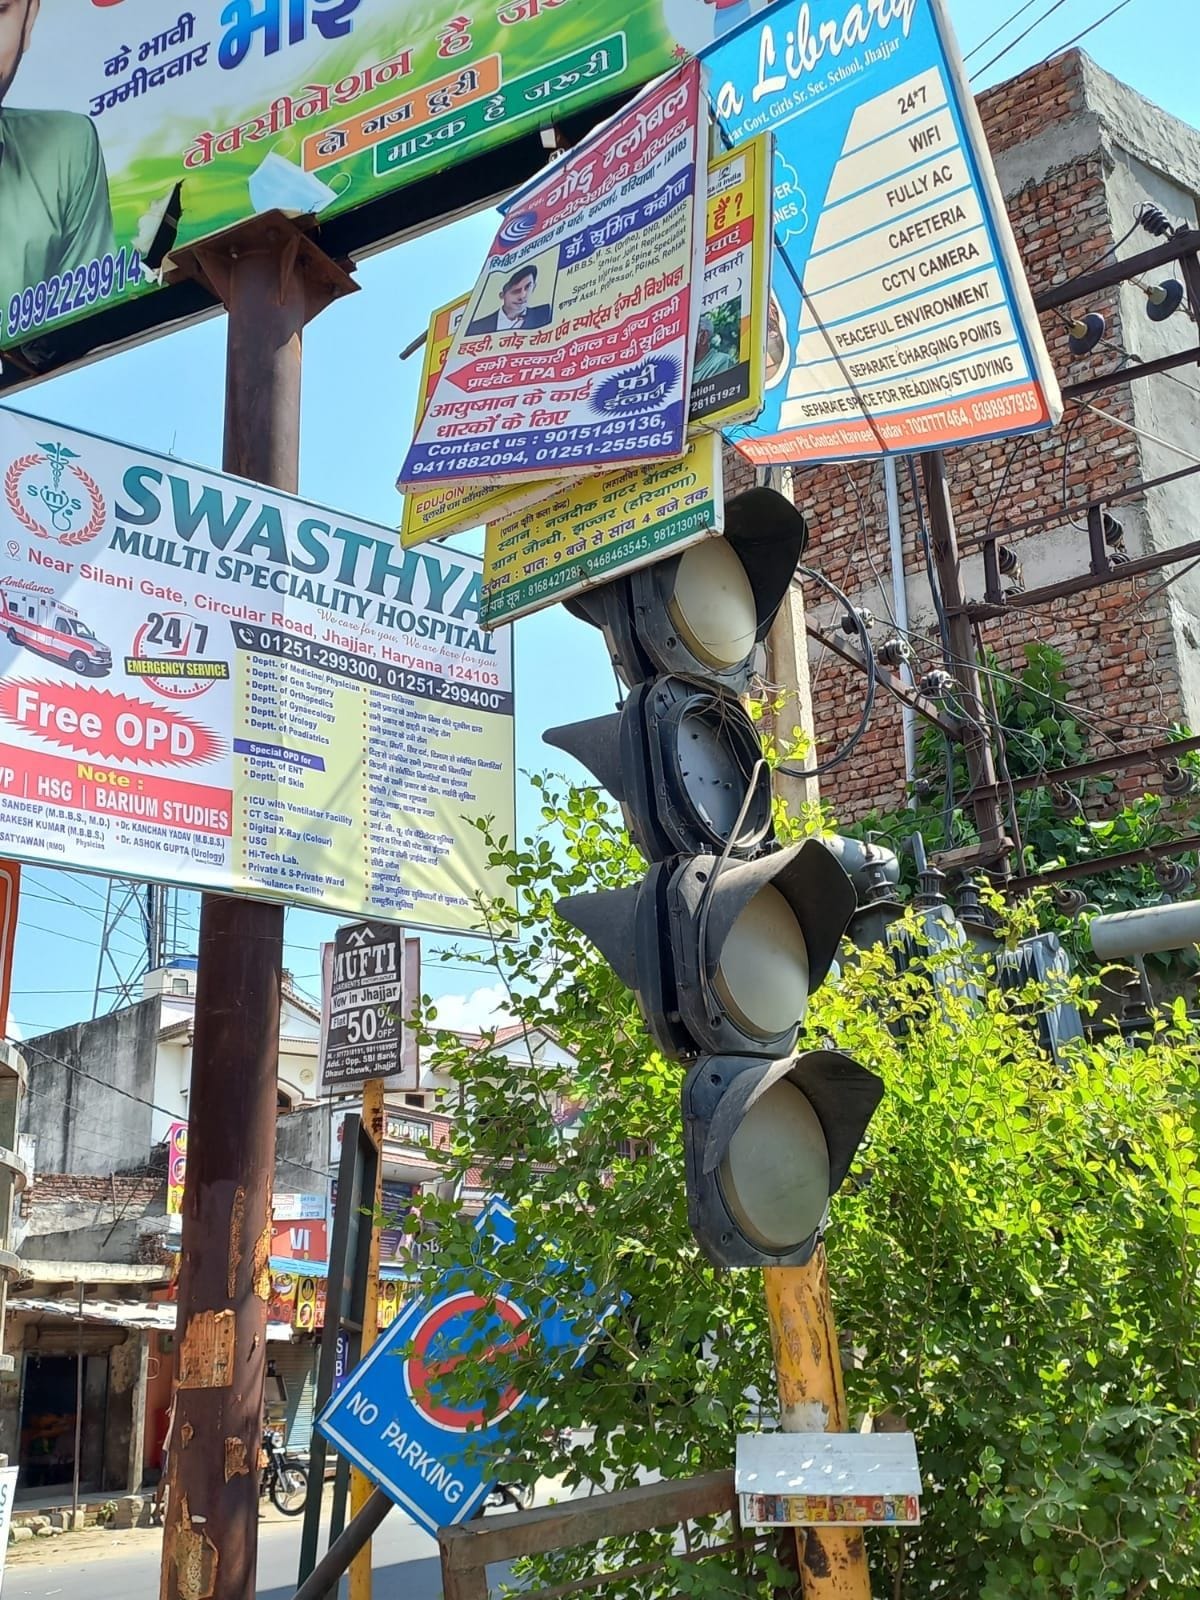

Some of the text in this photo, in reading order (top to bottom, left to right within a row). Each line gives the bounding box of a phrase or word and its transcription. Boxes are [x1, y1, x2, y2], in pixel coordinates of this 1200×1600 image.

[138, 12, 196, 61] भावी
[89, 42, 210, 117] उम्मीदवार
[744, 38, 900, 131] Govt. Girls Sr. Sec. School, Jhajjar
[184, 49, 412, 169] वैक्सीनेशन
[317, 70, 478, 155] दो गज दूरी
[603, 79, 690, 168] ग्लोबल
[388, 117, 466, 161] मास्क
[909, 126, 941, 153] WIFI
[519, 229, 554, 258] अस्पताल
[620, 169, 655, 196] हरियाणा
[664, 138, 687, 166] 124103
[886, 165, 953, 207] FULLY AC
[565, 234, 586, 258] डॉ.
[590, 210, 639, 248] सुमित
[643, 174, 689, 216] कंबोज
[889, 207, 965, 248] CAFETERIA
[572, 225, 687, 294] Sports Spine Specialist
[662, 238, 686, 258] Rohtak
[882, 244, 979, 292] CCTV CAMERA
[8, 247, 141, 336] 9992229914
[475, 296, 680, 373] सभी सरकारी पैनल व अन्य सभी
[836, 282, 990, 348] PEACEFUL ENVIRONMENT
[499, 331, 528, 349] जोड़
[529, 329, 552, 346] रोग
[519, 366, 556, 381] TPA
[581, 351, 618, 370] पैनल
[620, 339, 638, 359] की
[639, 320, 681, 353] सुविधा
[849, 320, 1001, 378] SEPARATE CHARGING POINTS
[430, 378, 593, 419] आयुष्मान कार्ड
[618, 364, 658, 393] फ्री
[801, 356, 1013, 418] SEPARATE SPACE FOR READING/STUDYING
[437, 408, 571, 438] धारकों लिए
[972, 390, 1038, 422] 8398937935
[412, 431, 673, 475] 9411882094, 01251-255565
[428, 413, 666, 457] Contact us 9015149136,
[416, 486, 465, 514] EDUJOIN
[545, 500, 598, 528] नजदीक
[602, 482, 638, 504] वाटर
[490, 551, 518, 571] ग्राम
[624, 472, 696, 513] (हरियाणा)
[554, 551, 561, 562] 9
[566, 537, 588, 556] बजे
[591, 530, 604, 546] से
[642, 513, 651, 524] 4
[656, 497, 680, 517] बजे
[684, 487, 709, 506] तक
[115, 466, 483, 625] SWASTHYA
[587, 536, 651, 571] 9468463545,
[108, 527, 496, 655] MULTI SPECIALITY HOSPITAL
[28, 548, 499, 686] Near Silani Gate, Circular Road, Jhajjar, Haryana 124103
[127, 660, 227, 678] EMERGENCY SERVICE
[260, 632, 500, 709] 01251-299300, 01251-299400
[290, 677, 334, 698] Gen Surgery
[326, 675, 360, 692] Physician
[289, 688, 333, 708] Orthopedics
[289, 701, 335, 723] Gynaecology
[17, 688, 194, 757] Free OPD
[289, 714, 317, 730] Urology
[250, 744, 311, 764] Special OPD for
[288, 765, 303, 775] ENT
[77, 763, 131, 787] Note
[288, 778, 304, 788] Skin
[0, 813, 66, 833] RAKESH KUMAR
[2, 798, 43, 814] SANDEEP
[38, 776, 229, 830] HSG BARIUM STUDIES
[249, 796, 352, 826] ICU with Ventilator Facility
[249, 810, 284, 822] CT Scan
[0, 832, 45, 848] SATYAWAN
[120, 820, 192, 841] Dr. KANCHAN YADAV
[120, 835, 132, 845] Dr.
[133, 838, 161, 850] ASHOK
[163, 843, 190, 856] GUPTA
[191, 848, 225, 863] (Urology)
[249, 822, 332, 847] Digital X-Ray (Colour)
[249, 836, 267, 846] USG
[249, 849, 299, 865] Hi-Tech Lab.
[249, 862, 344, 886] Private S-Private Ward
[296, 883, 324, 896] Facility
[334, 942, 396, 984] MUFTI
[349, 986, 397, 1004] in Jhajjar
[346, 1390, 464, 1505] NO PARKING
